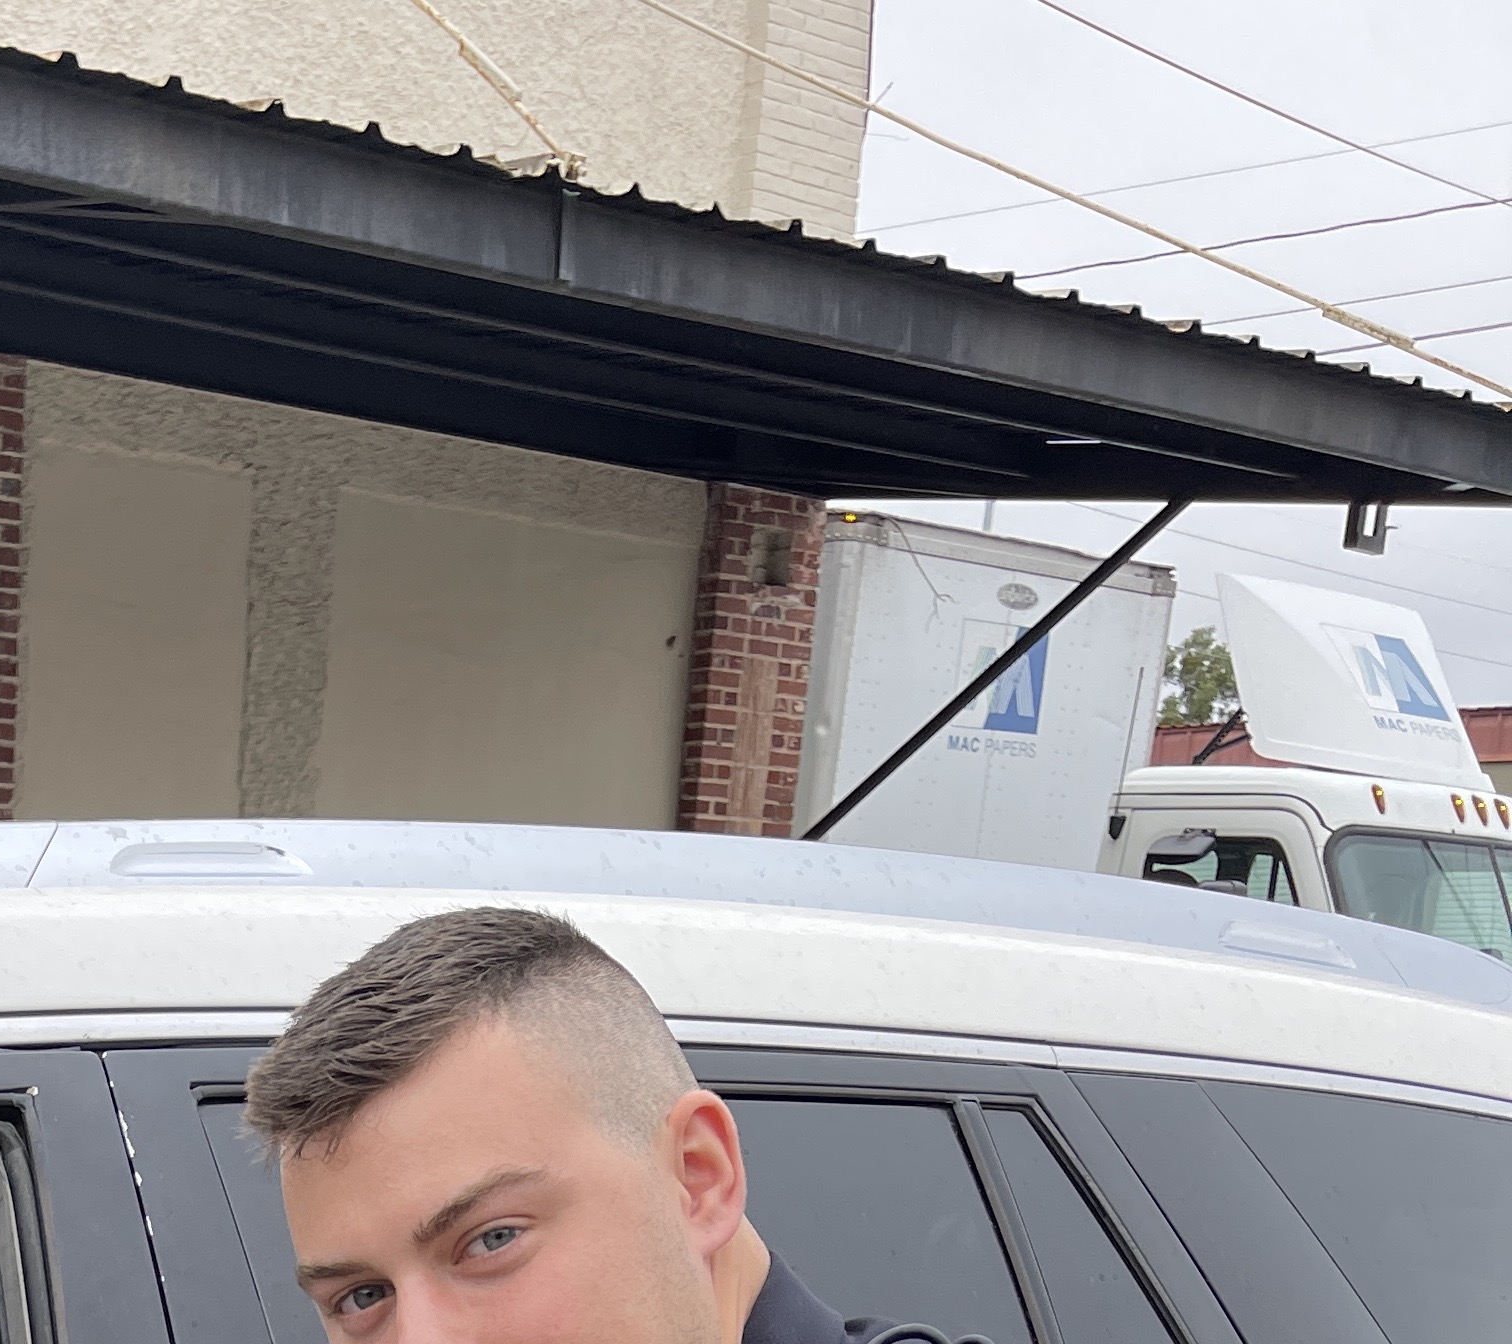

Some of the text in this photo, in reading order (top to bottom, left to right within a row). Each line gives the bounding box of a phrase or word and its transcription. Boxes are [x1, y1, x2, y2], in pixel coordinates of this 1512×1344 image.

[1373, 715, 1462, 743] MAC PAPERS
[947, 734, 1038, 759] MAC PAPERS
